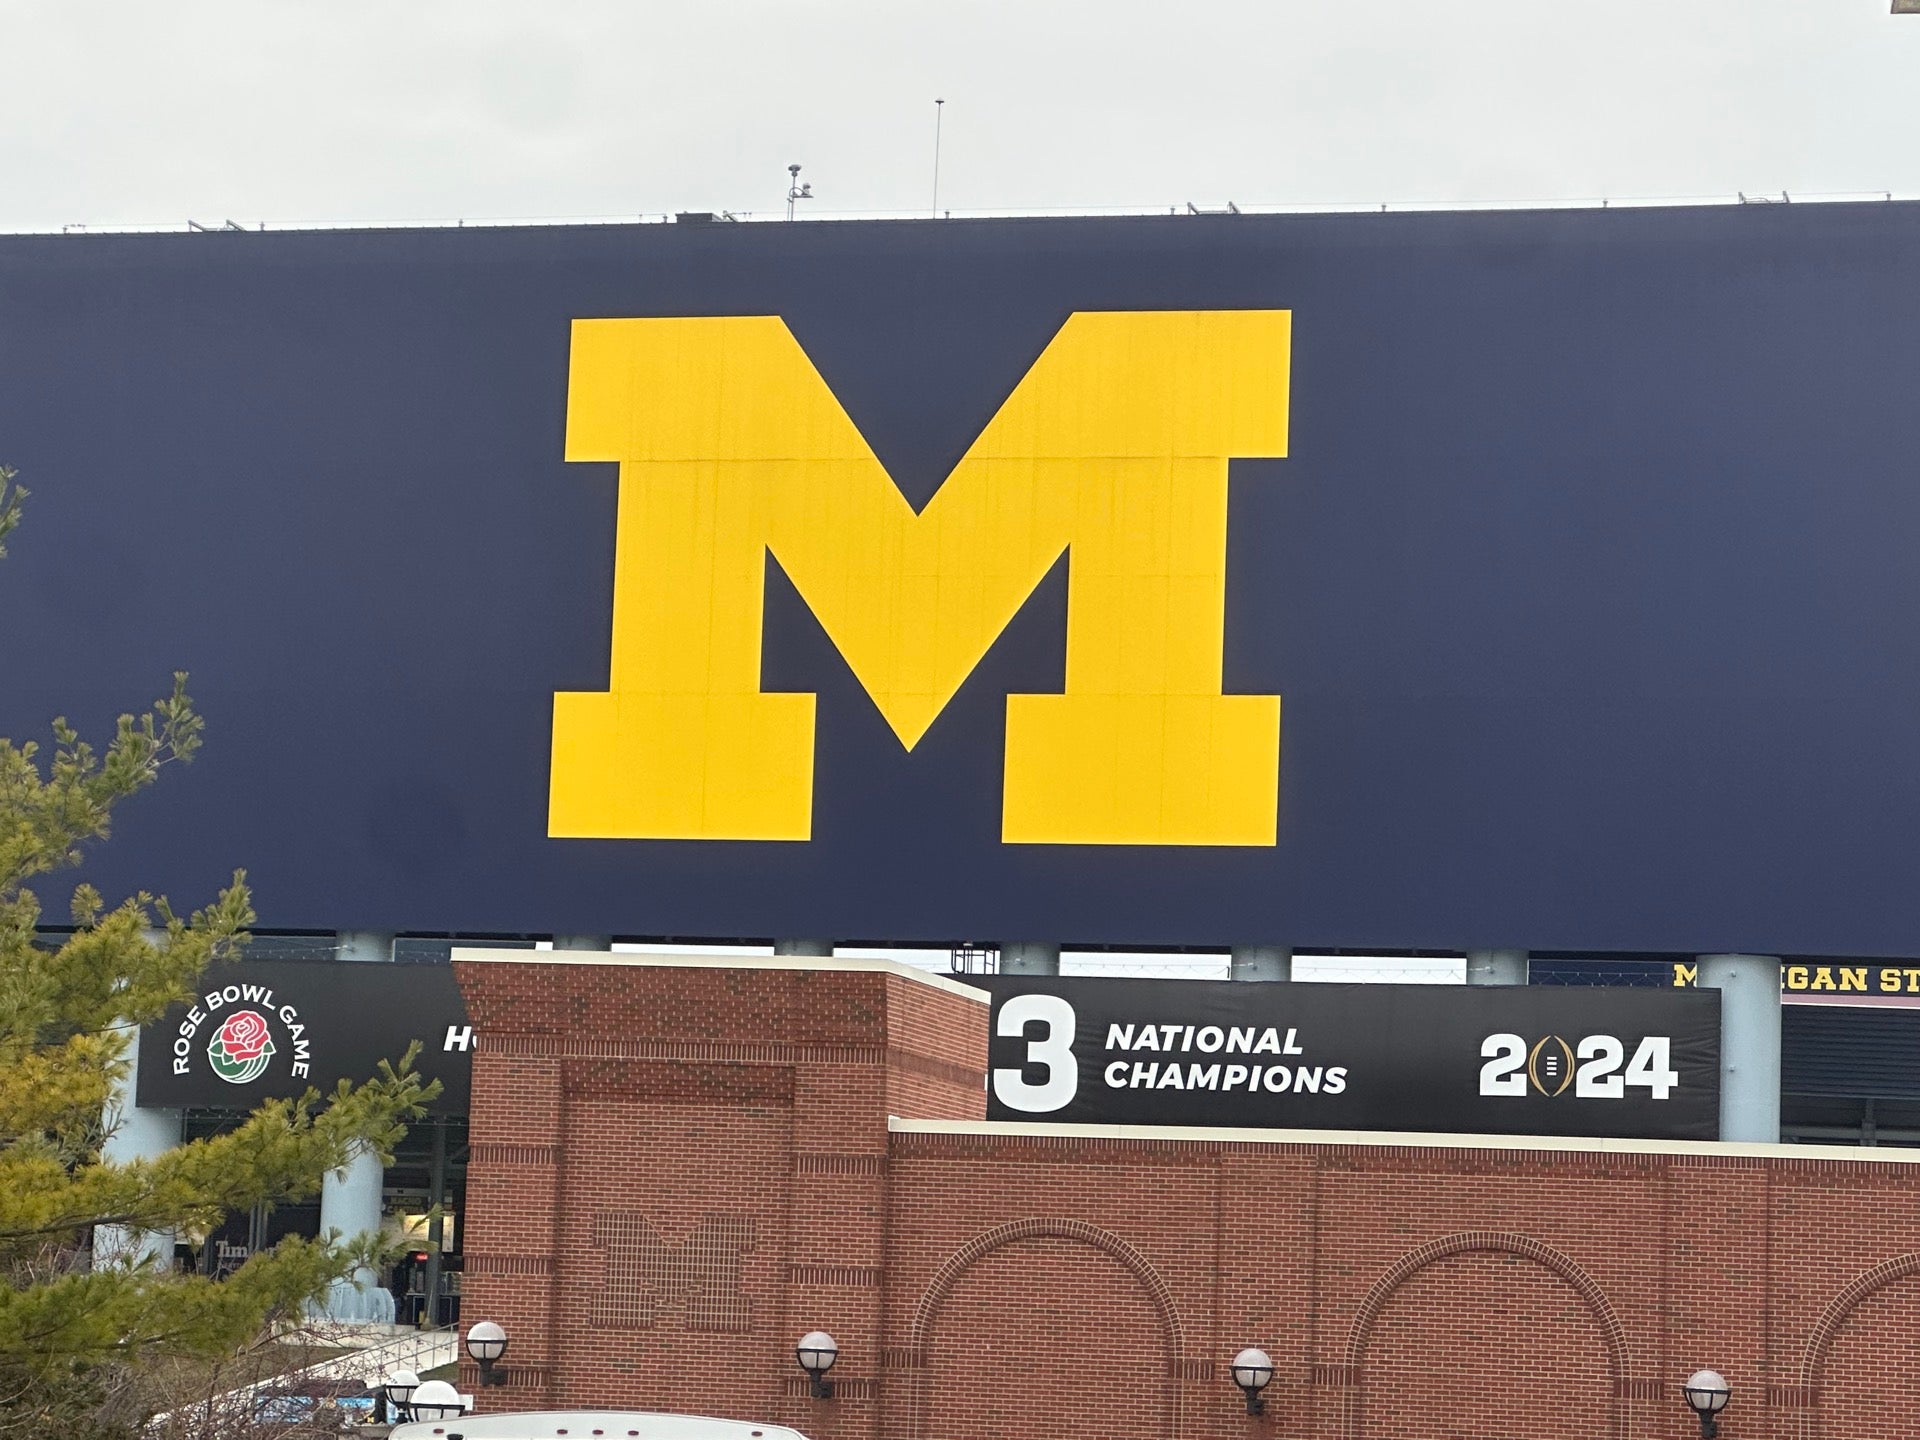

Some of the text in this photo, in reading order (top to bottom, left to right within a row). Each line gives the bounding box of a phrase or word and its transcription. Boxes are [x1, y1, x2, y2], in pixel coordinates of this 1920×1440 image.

[547, 309, 1292, 847] M
[1673, 963, 1868, 991] MGAN
[173, 983, 311, 1079] ROSE BOWL GAME
[443, 1025, 478, 1052] H
[1104, 1023, 1304, 1055] NATIONAL
[993, 993, 1079, 1113] 3
[1104, 1060, 1348, 1095] CHAMPIONS
